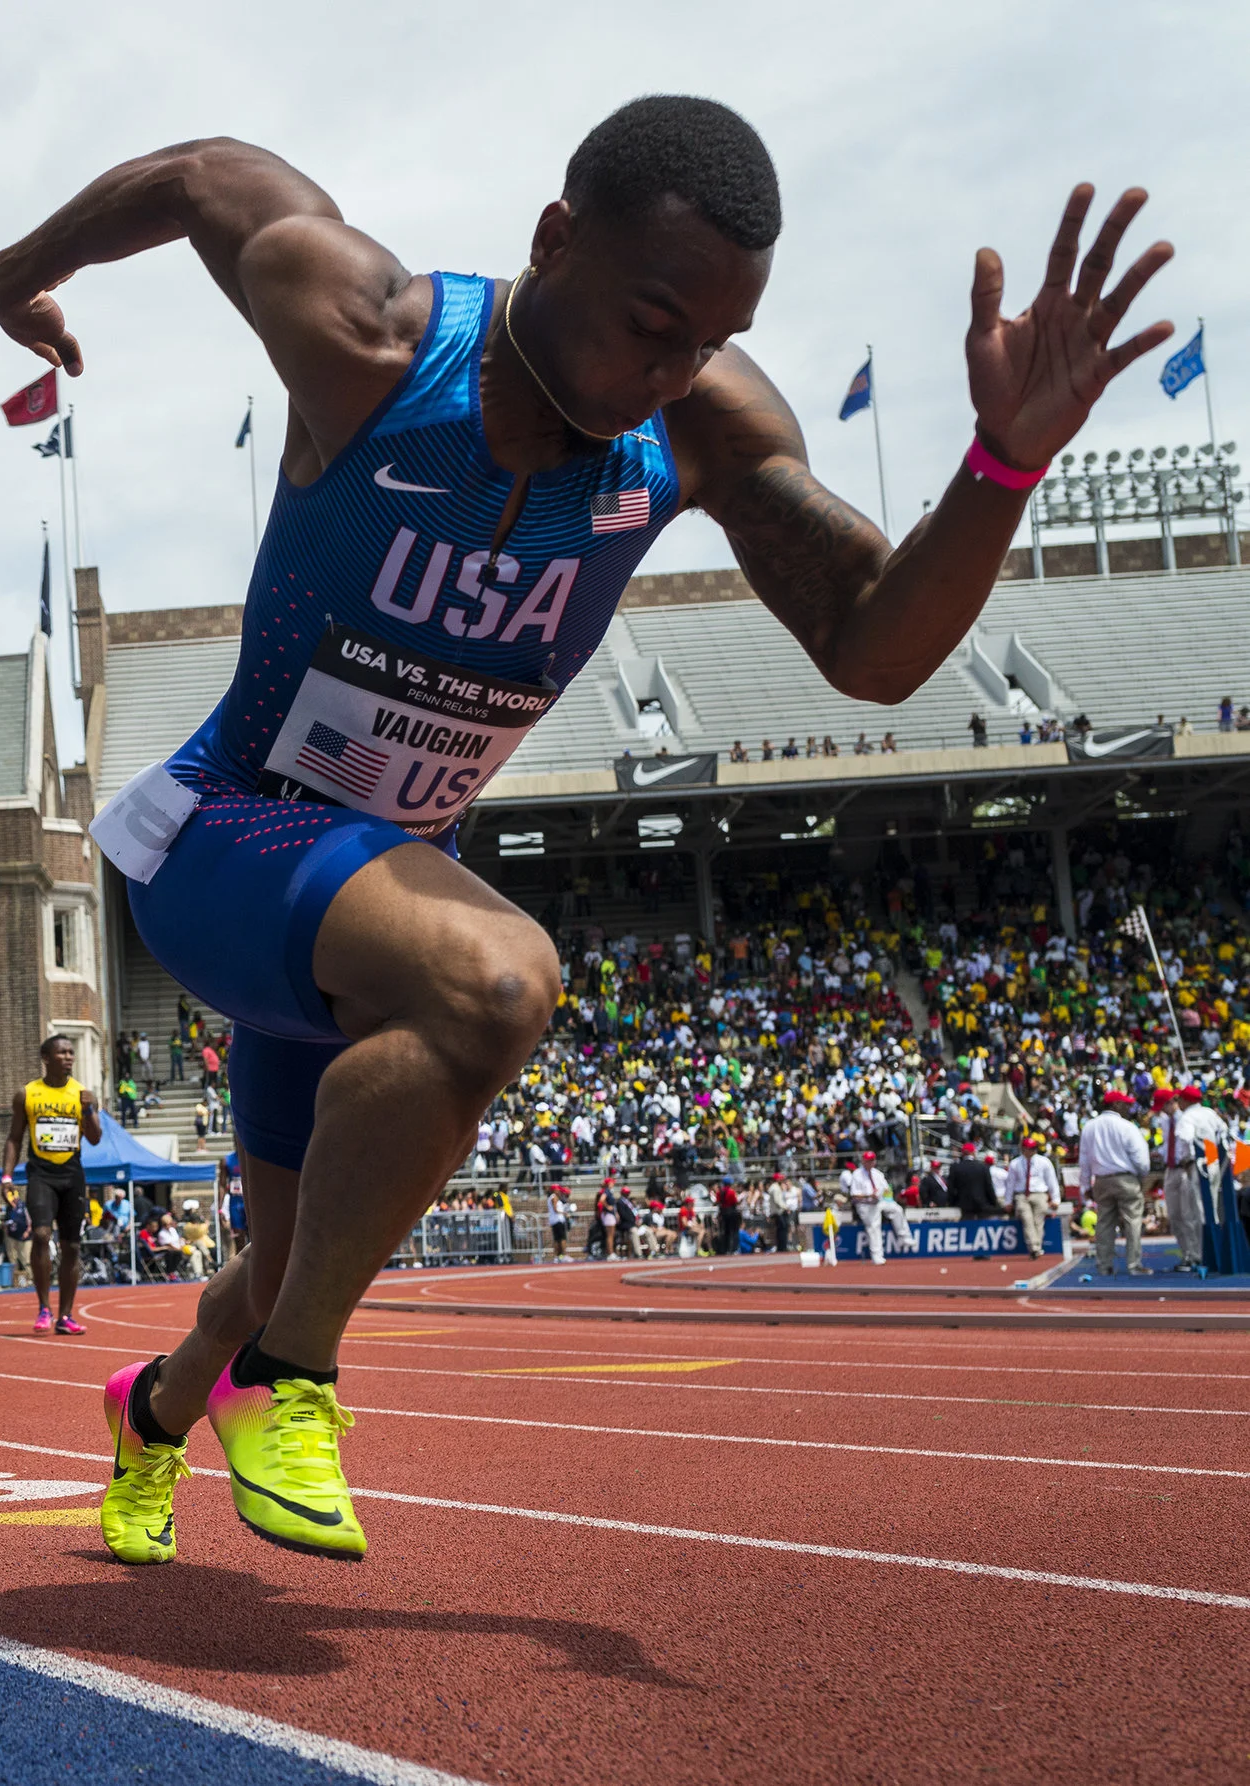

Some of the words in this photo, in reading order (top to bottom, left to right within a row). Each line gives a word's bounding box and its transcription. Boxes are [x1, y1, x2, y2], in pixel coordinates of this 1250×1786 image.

[370, 526, 581, 643] USA
[340, 639, 387, 673] USA
[396, 658, 429, 686] VS.
[437, 673, 484, 701] THE
[486, 688, 554, 712] WORL
[406, 687, 442, 707] PENN
[442, 700, 490, 719] RELAYS
[371, 707, 494, 760] VAUGHN
[33, 1103, 77, 1116] JAMAICA
[856, 1229, 921, 1255] PNN
[927, 1225, 1018, 1253] RELAYS
